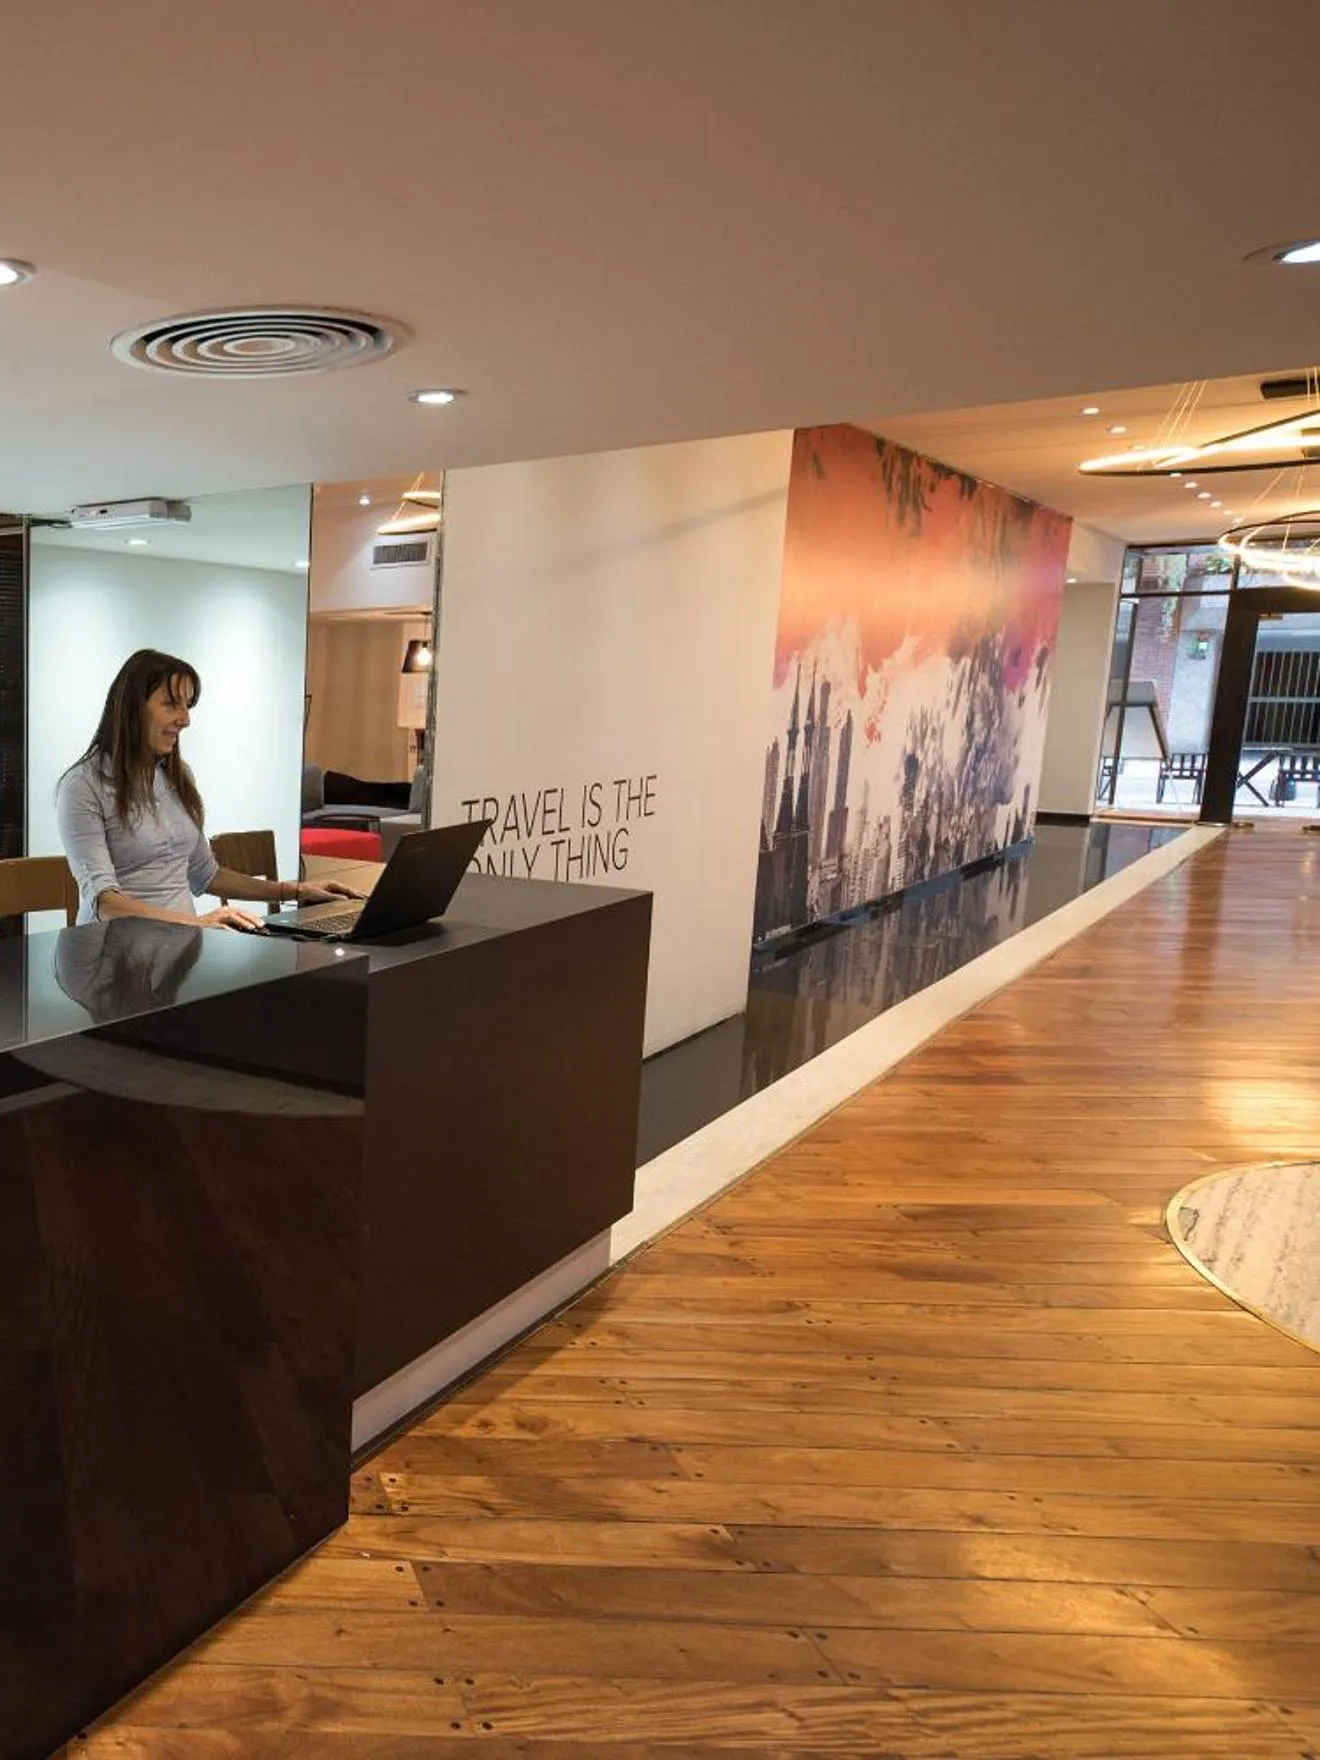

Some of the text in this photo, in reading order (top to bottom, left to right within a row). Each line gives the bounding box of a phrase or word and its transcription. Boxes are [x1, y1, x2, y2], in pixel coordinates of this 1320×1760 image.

[461, 774, 658, 847] TRAVEL IS THE
[471, 827, 629, 882] NLY THING
